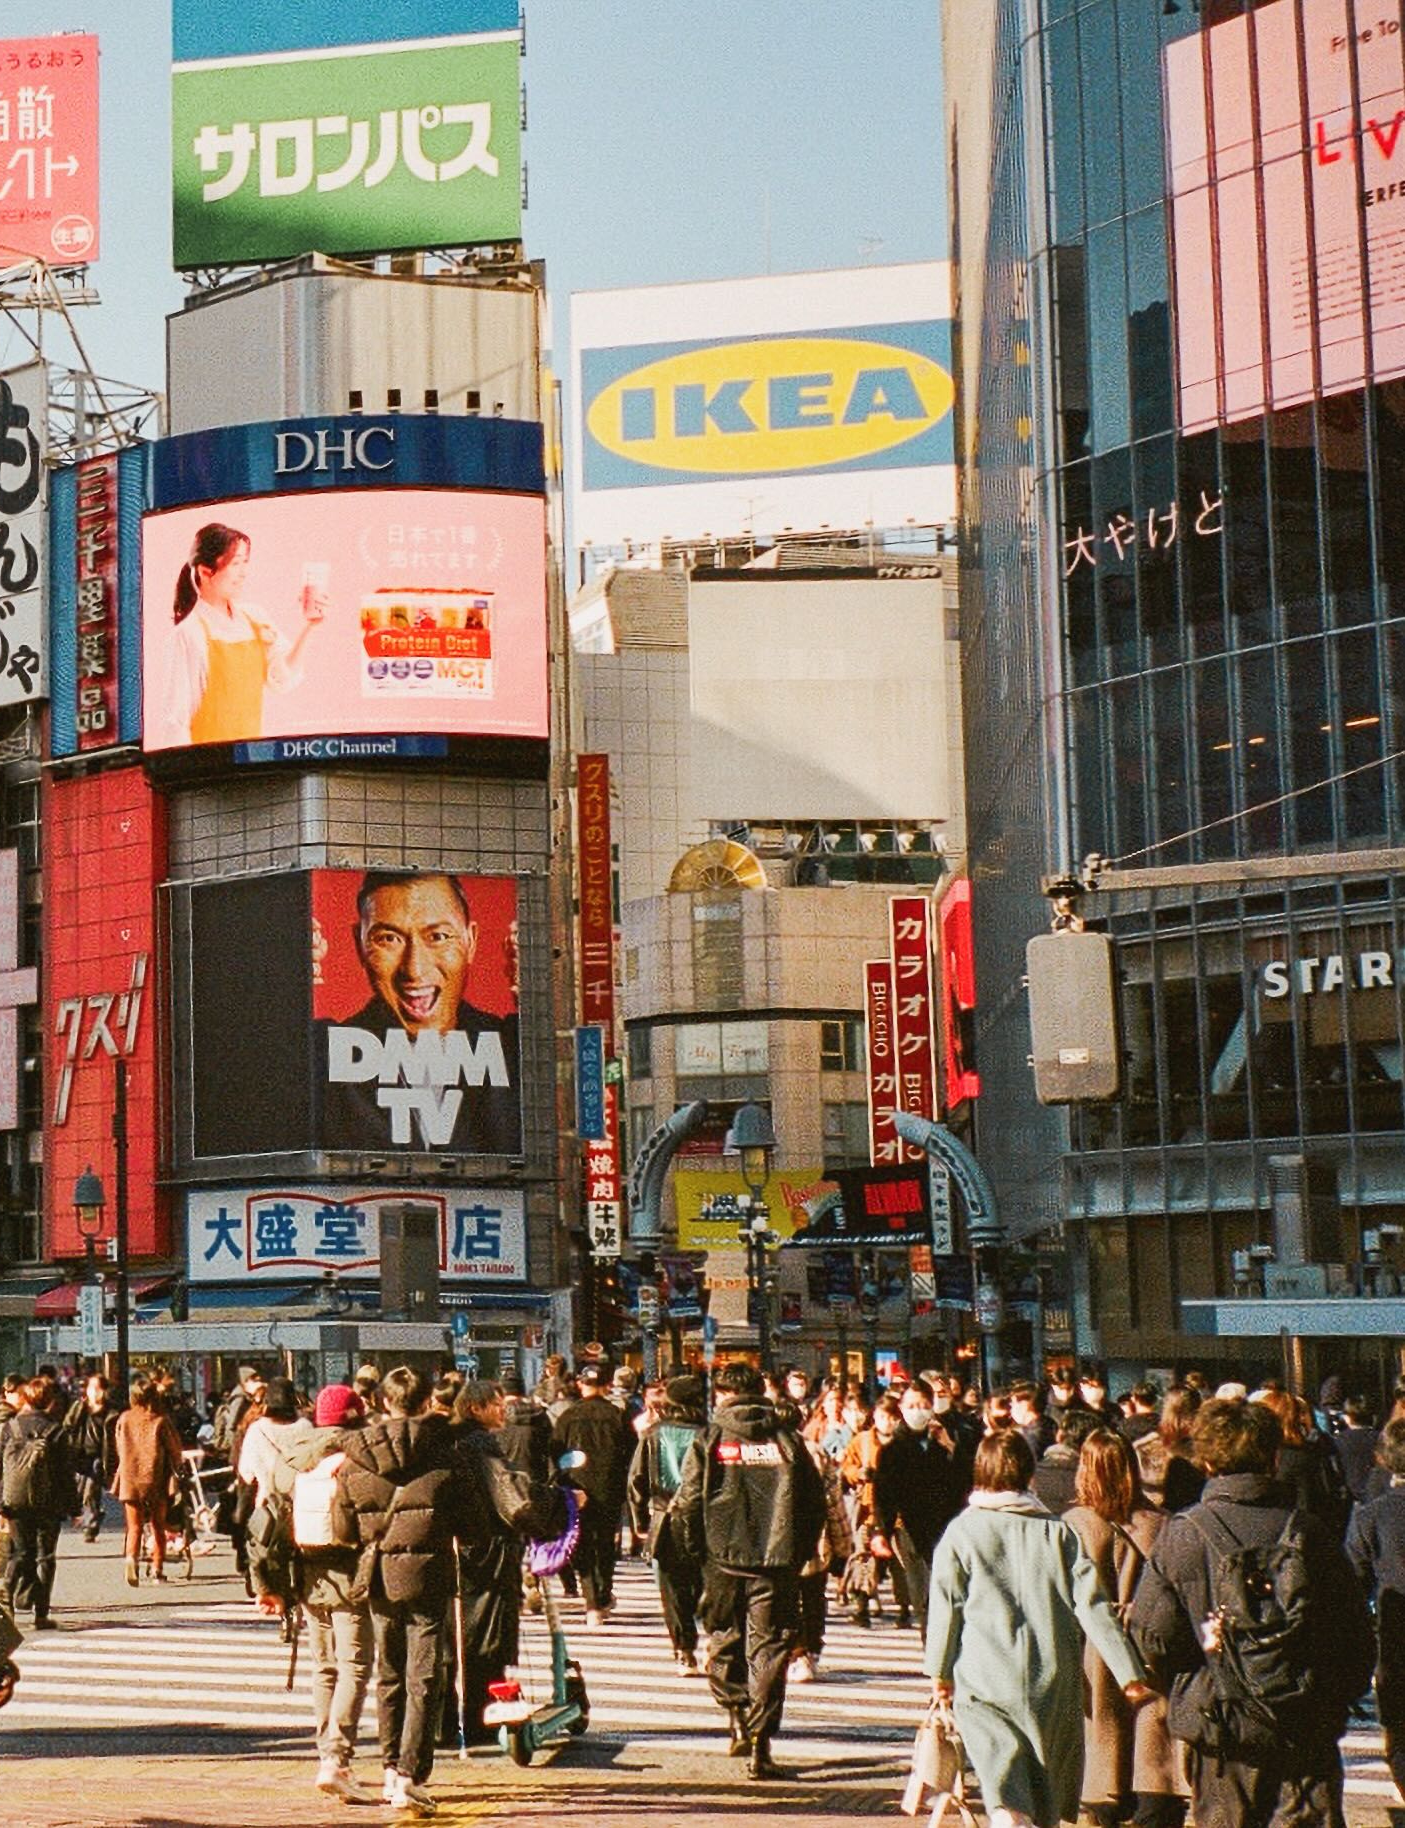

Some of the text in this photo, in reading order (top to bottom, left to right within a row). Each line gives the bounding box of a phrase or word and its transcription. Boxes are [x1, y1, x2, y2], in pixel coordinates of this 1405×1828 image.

[1330, 18, 1400, 53] Fre To
[193, 102, 499, 202] サロンパス
[1363, 180, 1405, 207] ERFE
[620, 366, 929, 443] IKEA
[274, 427, 394, 475] DHC
[380, 634, 478, 651] Protein Diet
[437, 661, 487, 679] MCT
[283, 737, 397, 757] DHC Channel
[897, 917, 928, 1056] カラオケ
[1264, 951, 1394, 999] STAR
[51, 952, 148, 1127] クスリ
[327, 1025, 510, 1088] DMM
[903, 1073, 922, 1107] BIG
[377, 1087, 464, 1150] TV
[204, 1203, 502, 1261] 大盛堂店
